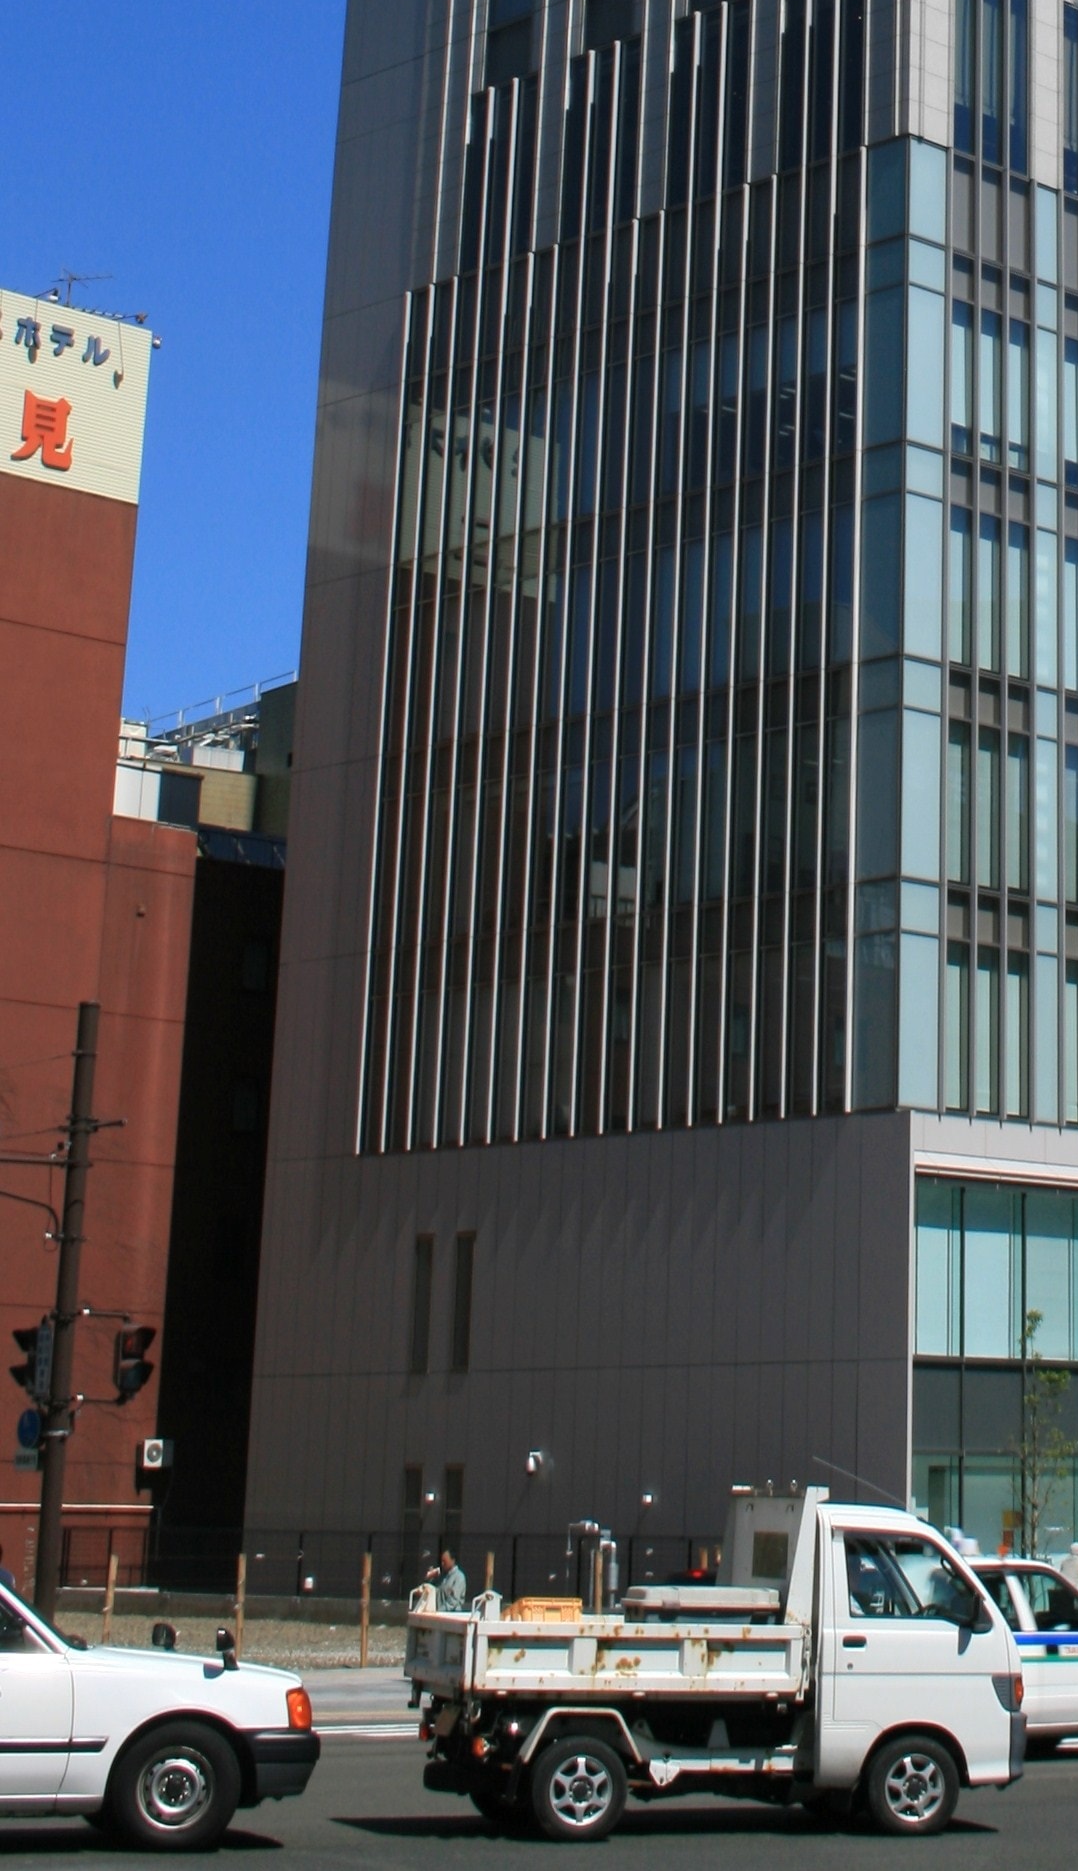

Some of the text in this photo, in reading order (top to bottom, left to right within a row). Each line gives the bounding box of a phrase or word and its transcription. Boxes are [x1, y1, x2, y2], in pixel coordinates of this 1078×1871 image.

[0, 310, 111, 367] ホテル
[10, 388, 74, 471] 見
